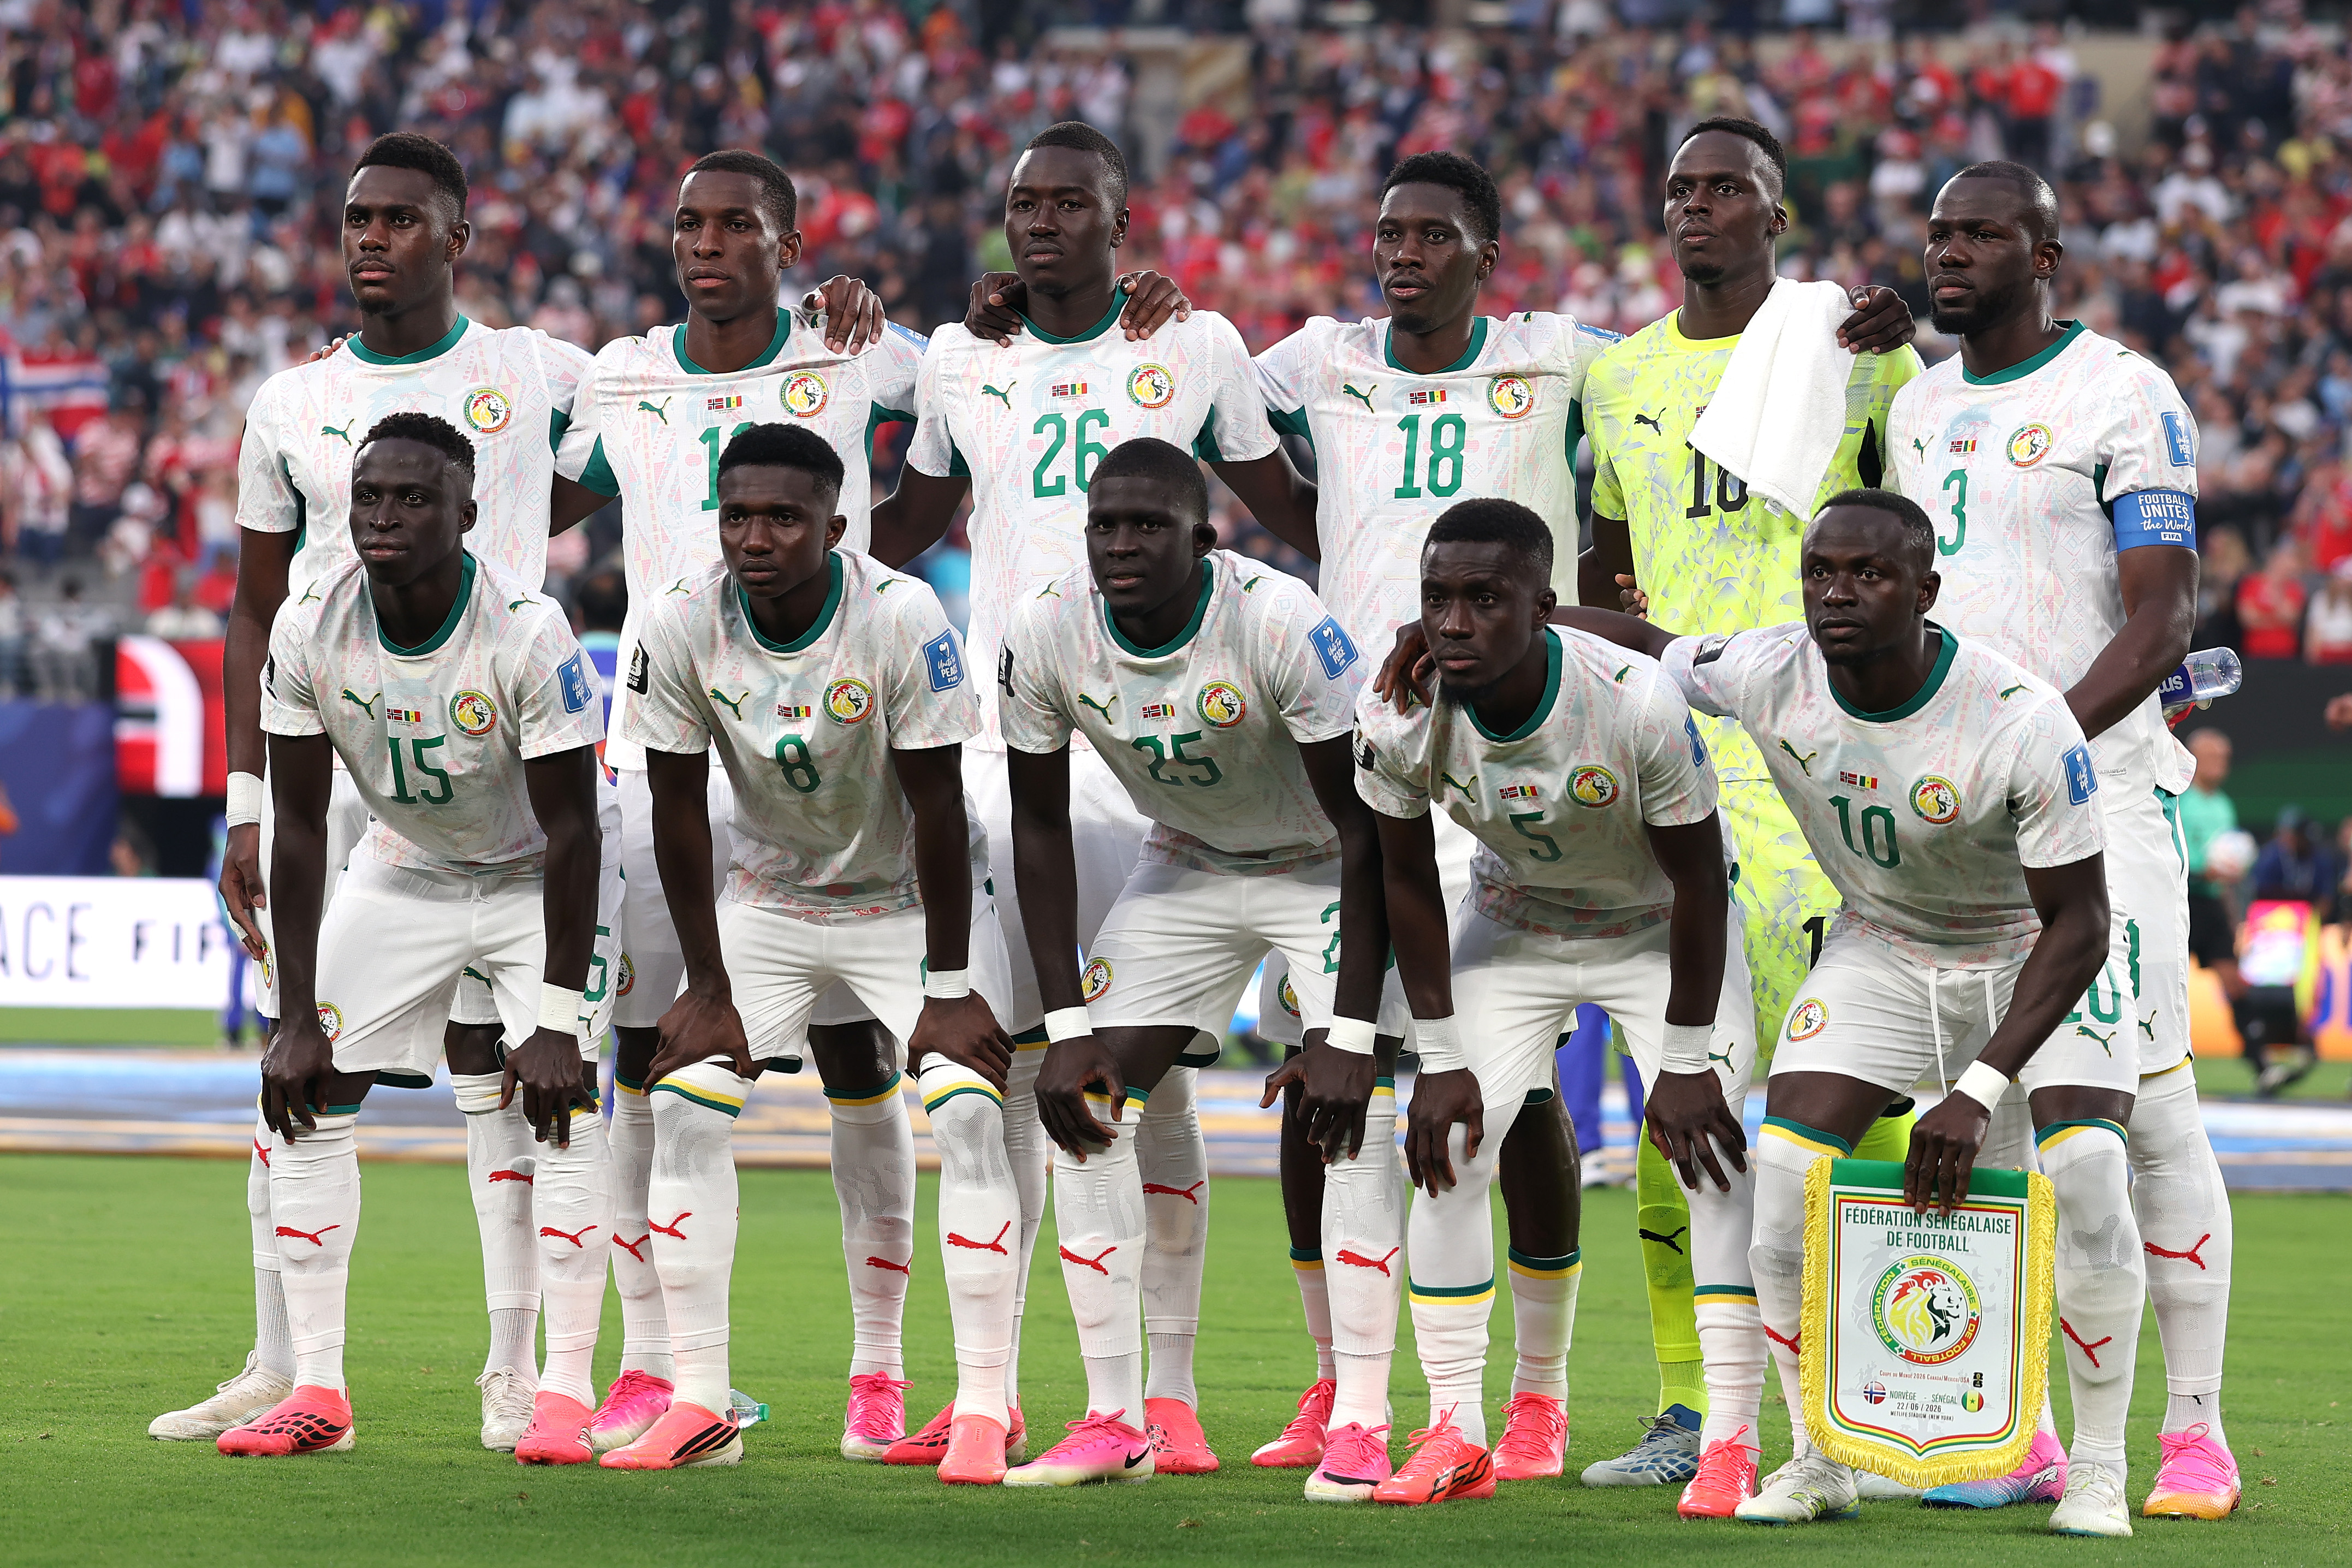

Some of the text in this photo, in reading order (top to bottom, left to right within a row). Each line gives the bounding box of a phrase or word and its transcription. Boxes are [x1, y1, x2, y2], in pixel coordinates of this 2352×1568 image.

[698, 421, 754, 511] 1
[1033, 408, 1109, 498] 26
[1394, 413, 1466, 499] 18
[1938, 468, 1968, 556] 3
[2138, 494, 2187, 507] FOOTBALL
[2140, 504, 2189, 520] UNITES
[2140, 518, 2192, 534] the World
[388, 734, 454, 805] 15
[775, 733, 822, 793] 8
[1131, 729, 1223, 787] 25
[1509, 811, 1564, 863] 5
[1828, 794, 1900, 869] 10
[133, 919, 224, 964] FIF
[583, 924, 611, 1002] 5
[1320, 900, 1341, 974] 2
[2061, 959, 2122, 1025] 0
[1845, 1206, 1922, 1228] FÉDÉRATION
[1887, 1231, 1969, 1252] DE FOOTBALL
[1874, 1270, 1896, 1343] FÉDÉRATION
[1910, 1257, 1976, 1304] SÉNÉGALAISE
[1910, 1323, 1975, 1362] DE FOOTBALL
[1890, 1390, 1917, 1400] NORVÈGE
[1932, 1393, 1957, 1404] SÉNÉGAL
[1926, 1404, 1941, 1412] 2026
